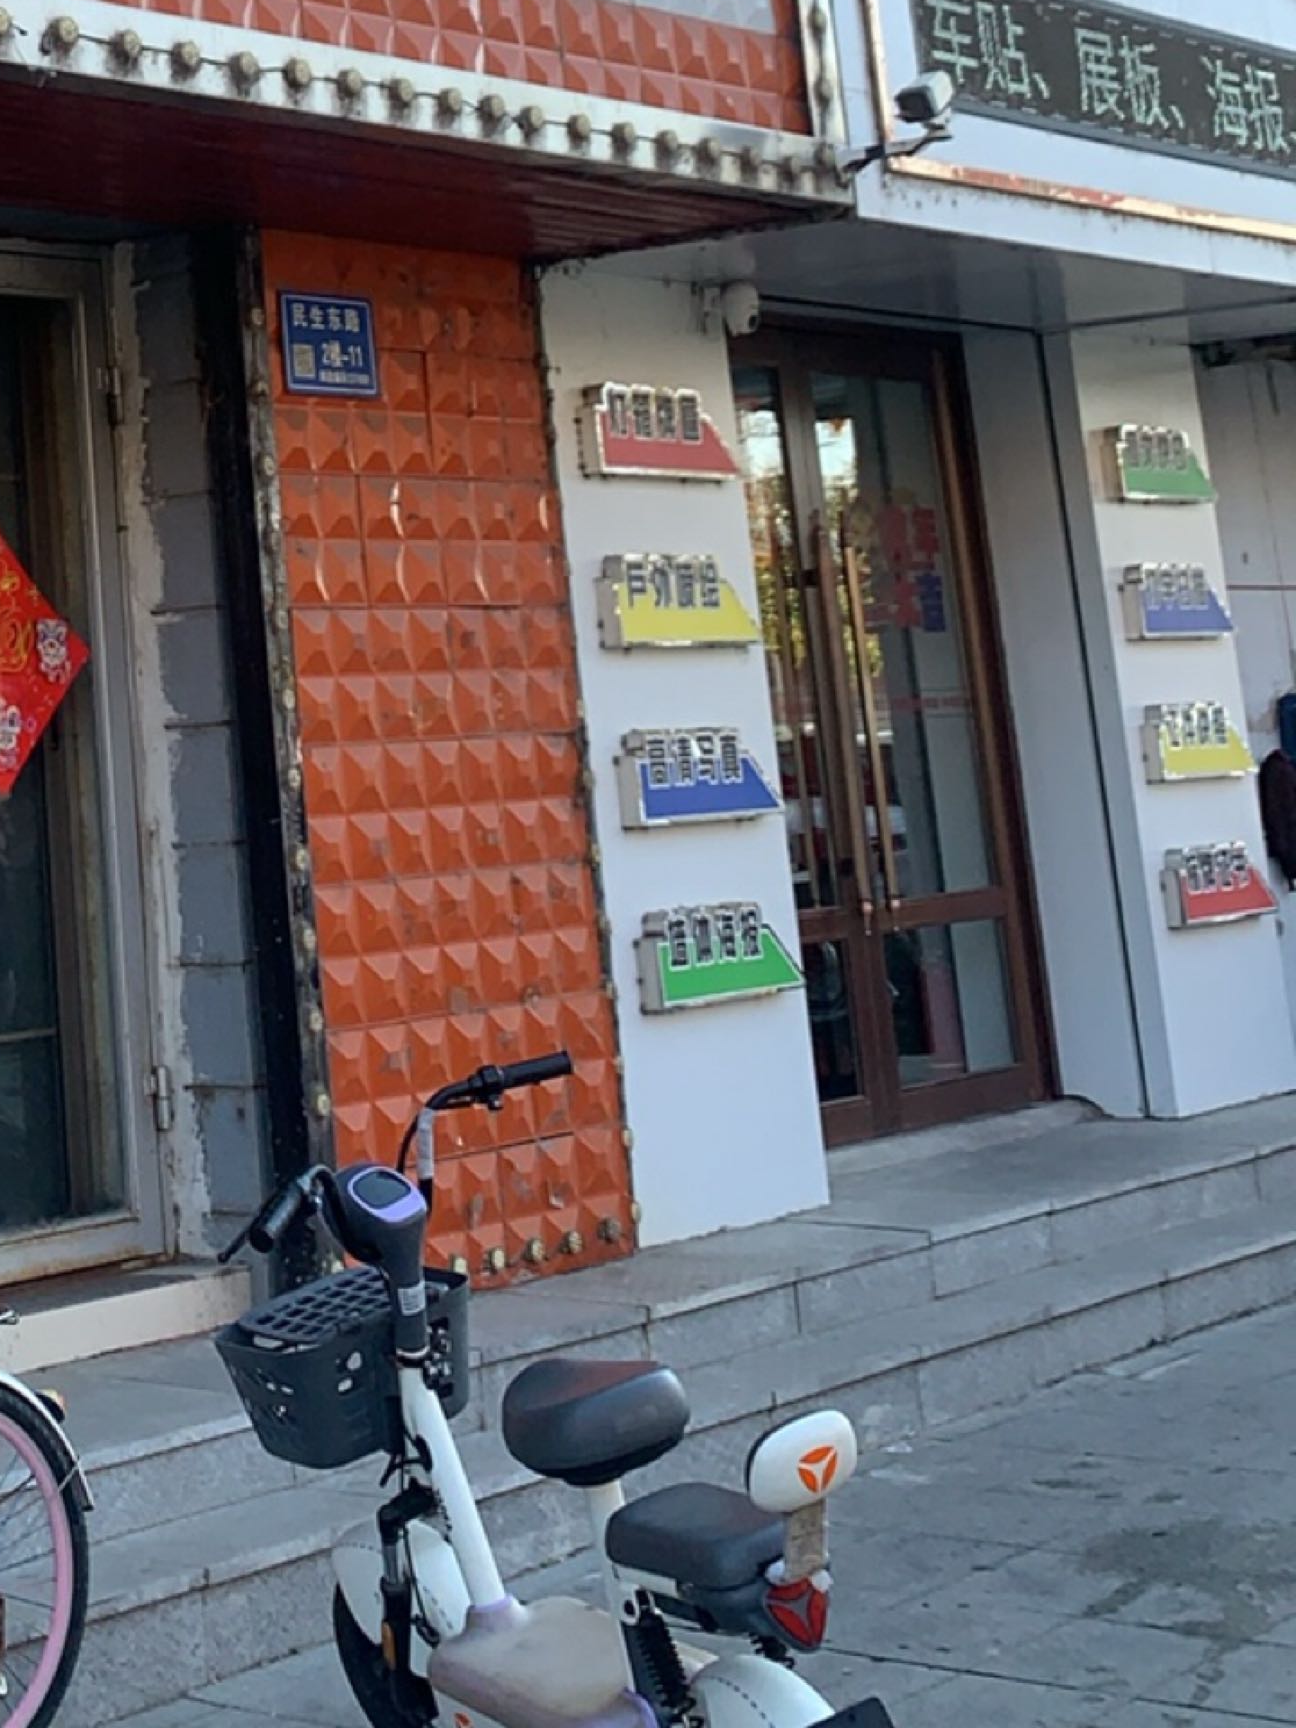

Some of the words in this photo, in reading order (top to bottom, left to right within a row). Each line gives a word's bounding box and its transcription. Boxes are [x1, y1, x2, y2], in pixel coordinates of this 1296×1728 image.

[291, 301, 361, 333] 民生东路
[646, 732, 742, 785] 高清写真
